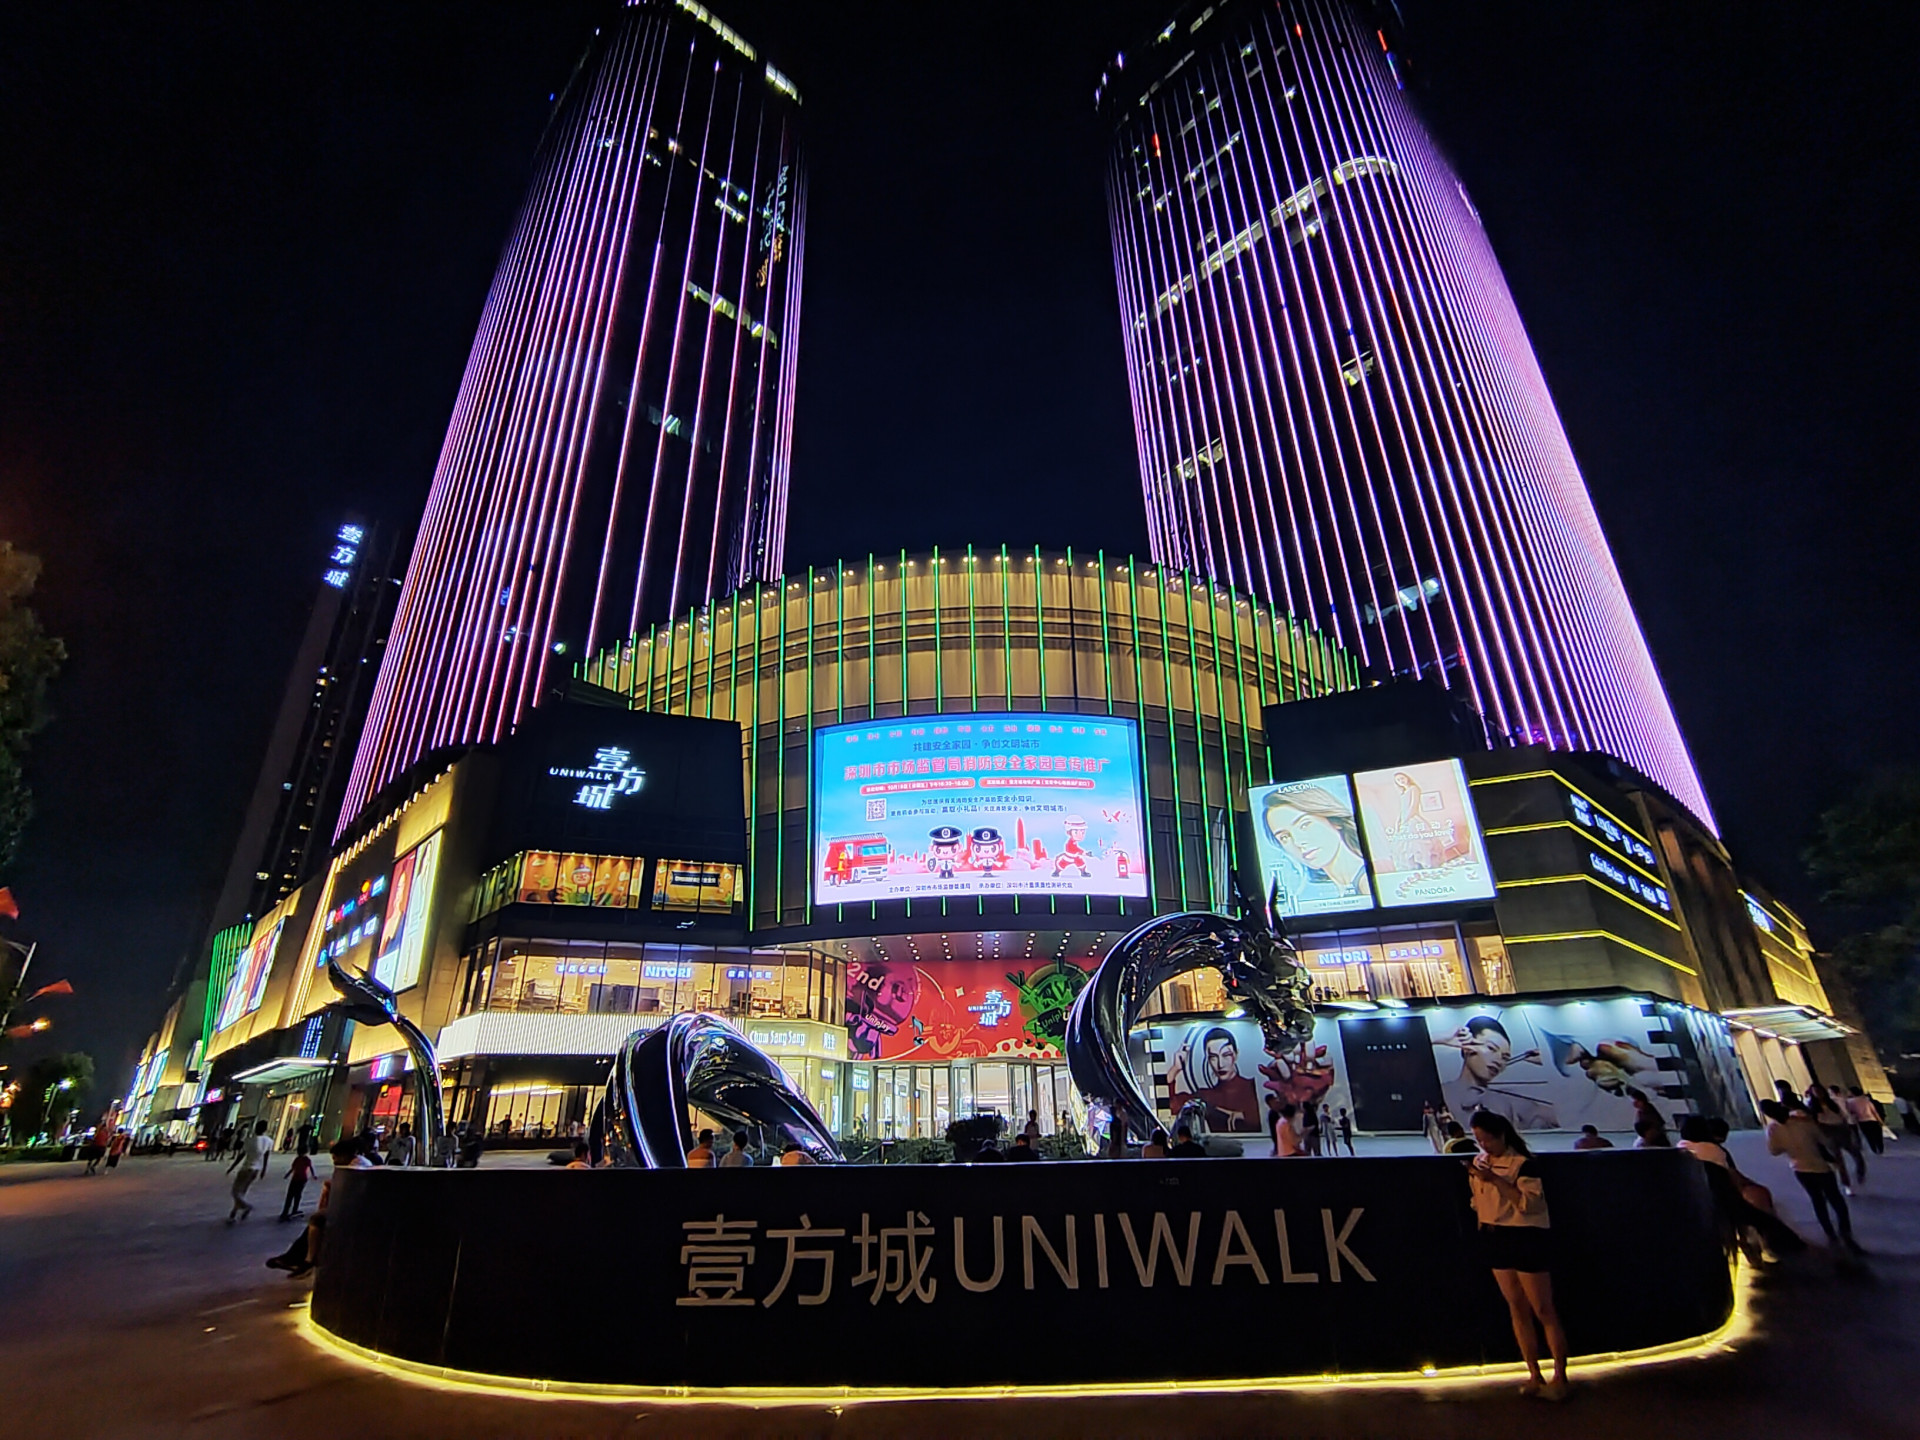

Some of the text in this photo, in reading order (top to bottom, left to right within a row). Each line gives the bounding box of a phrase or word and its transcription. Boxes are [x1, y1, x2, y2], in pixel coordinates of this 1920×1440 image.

[323, 524, 363, 588] 壹方城
[549, 767, 613, 781] UNIWALK
[573, 746, 646, 810] 壹方城
[843, 755, 1111, 781] 深圳市市场监管局消防安全家园宣传推广
[1415, 886, 1456, 896] PANDORA
[1318, 950, 1369, 965] NITORI
[645, 965, 692, 978] NITORI
[847, 962, 885, 991] 2nd
[749, 1030, 806, 1047] Chow Sang Sang
[676, 1208, 1377, 1308] 壹方城 UNIWALK
